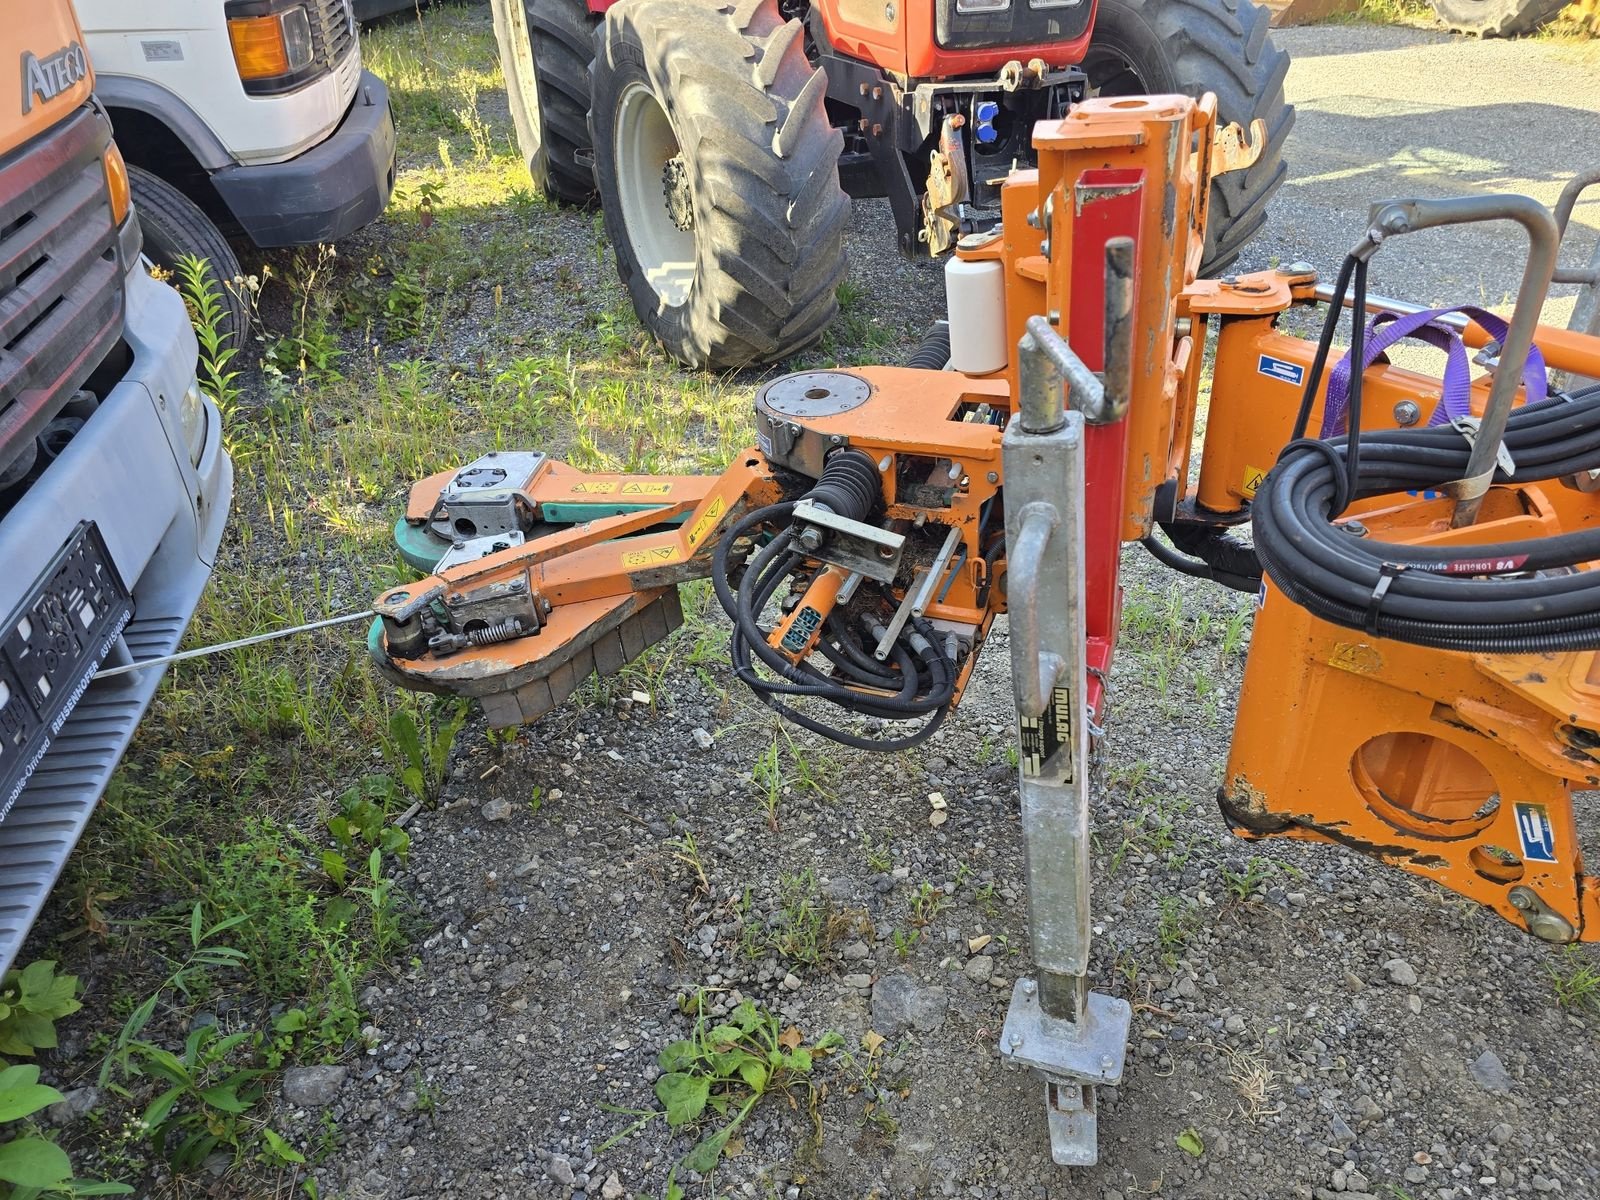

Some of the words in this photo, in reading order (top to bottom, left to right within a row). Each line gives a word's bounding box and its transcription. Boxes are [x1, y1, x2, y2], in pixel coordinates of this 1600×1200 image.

[22, 43, 87, 114] ATEGO
[51, 660, 100, 735] REISENHOFER
[1054, 688, 1070, 742] MULAG
